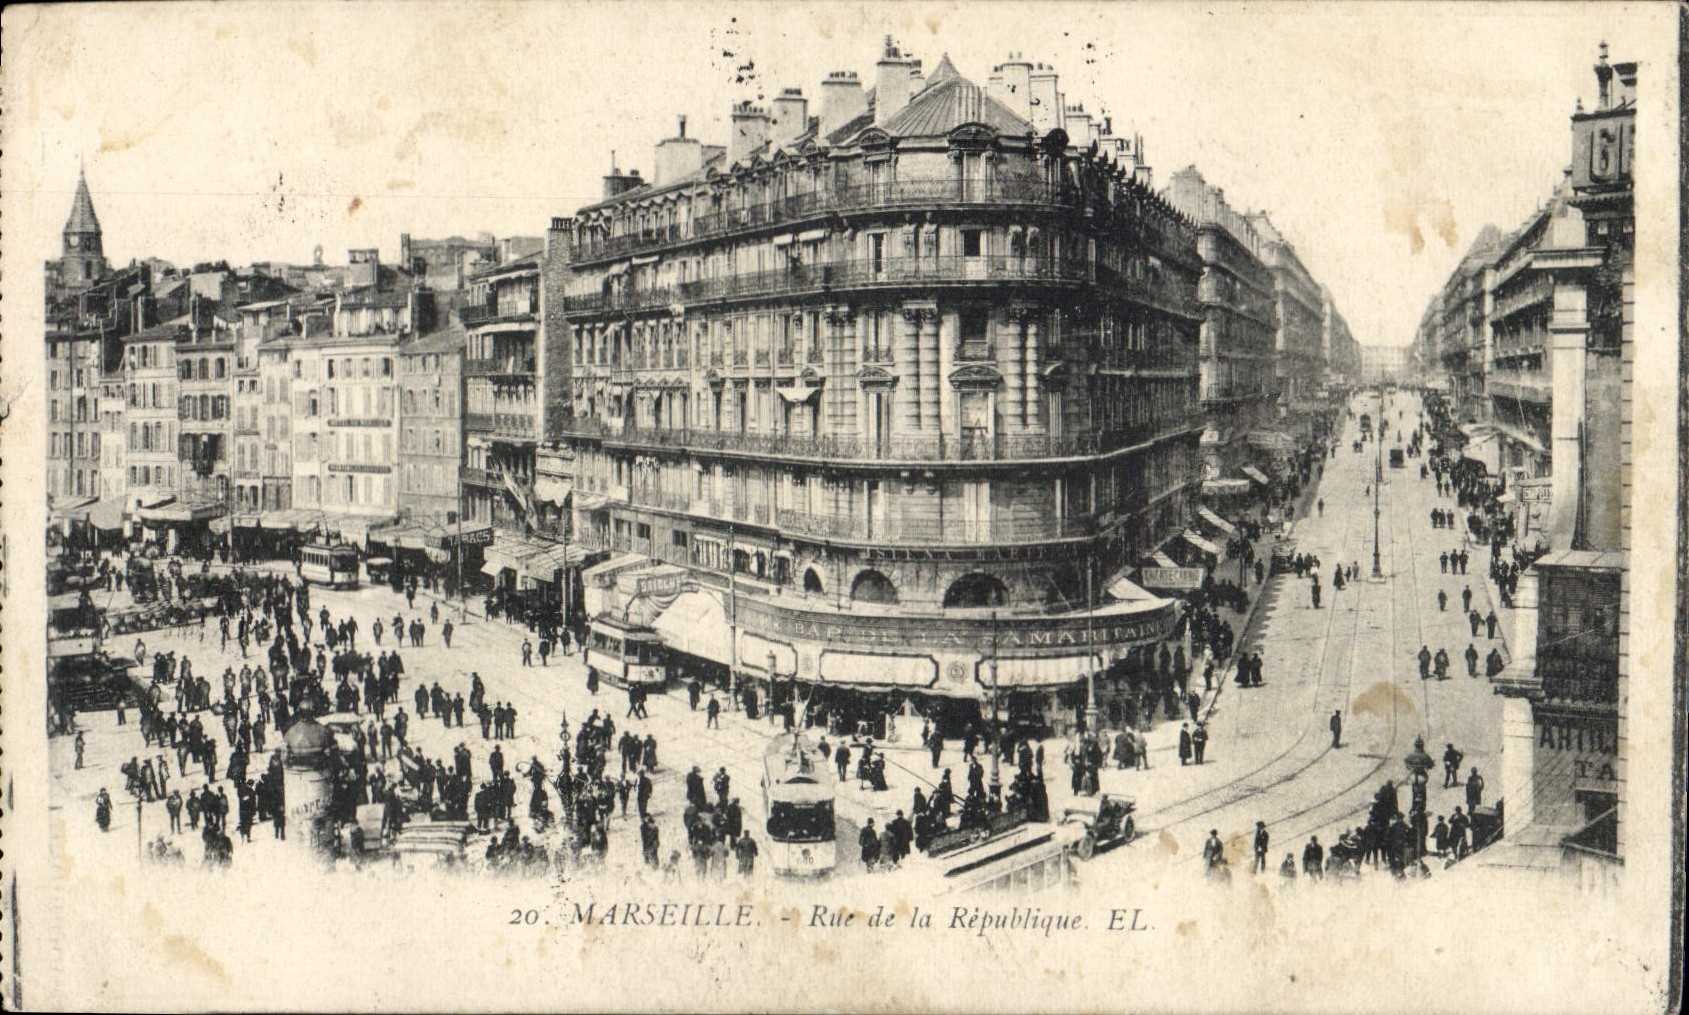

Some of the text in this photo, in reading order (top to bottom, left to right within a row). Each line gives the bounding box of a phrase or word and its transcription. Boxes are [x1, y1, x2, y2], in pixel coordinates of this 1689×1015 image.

[794, 622, 841, 640] BAR
[862, 630, 899, 643] DE
[921, 631, 964, 645] LA
